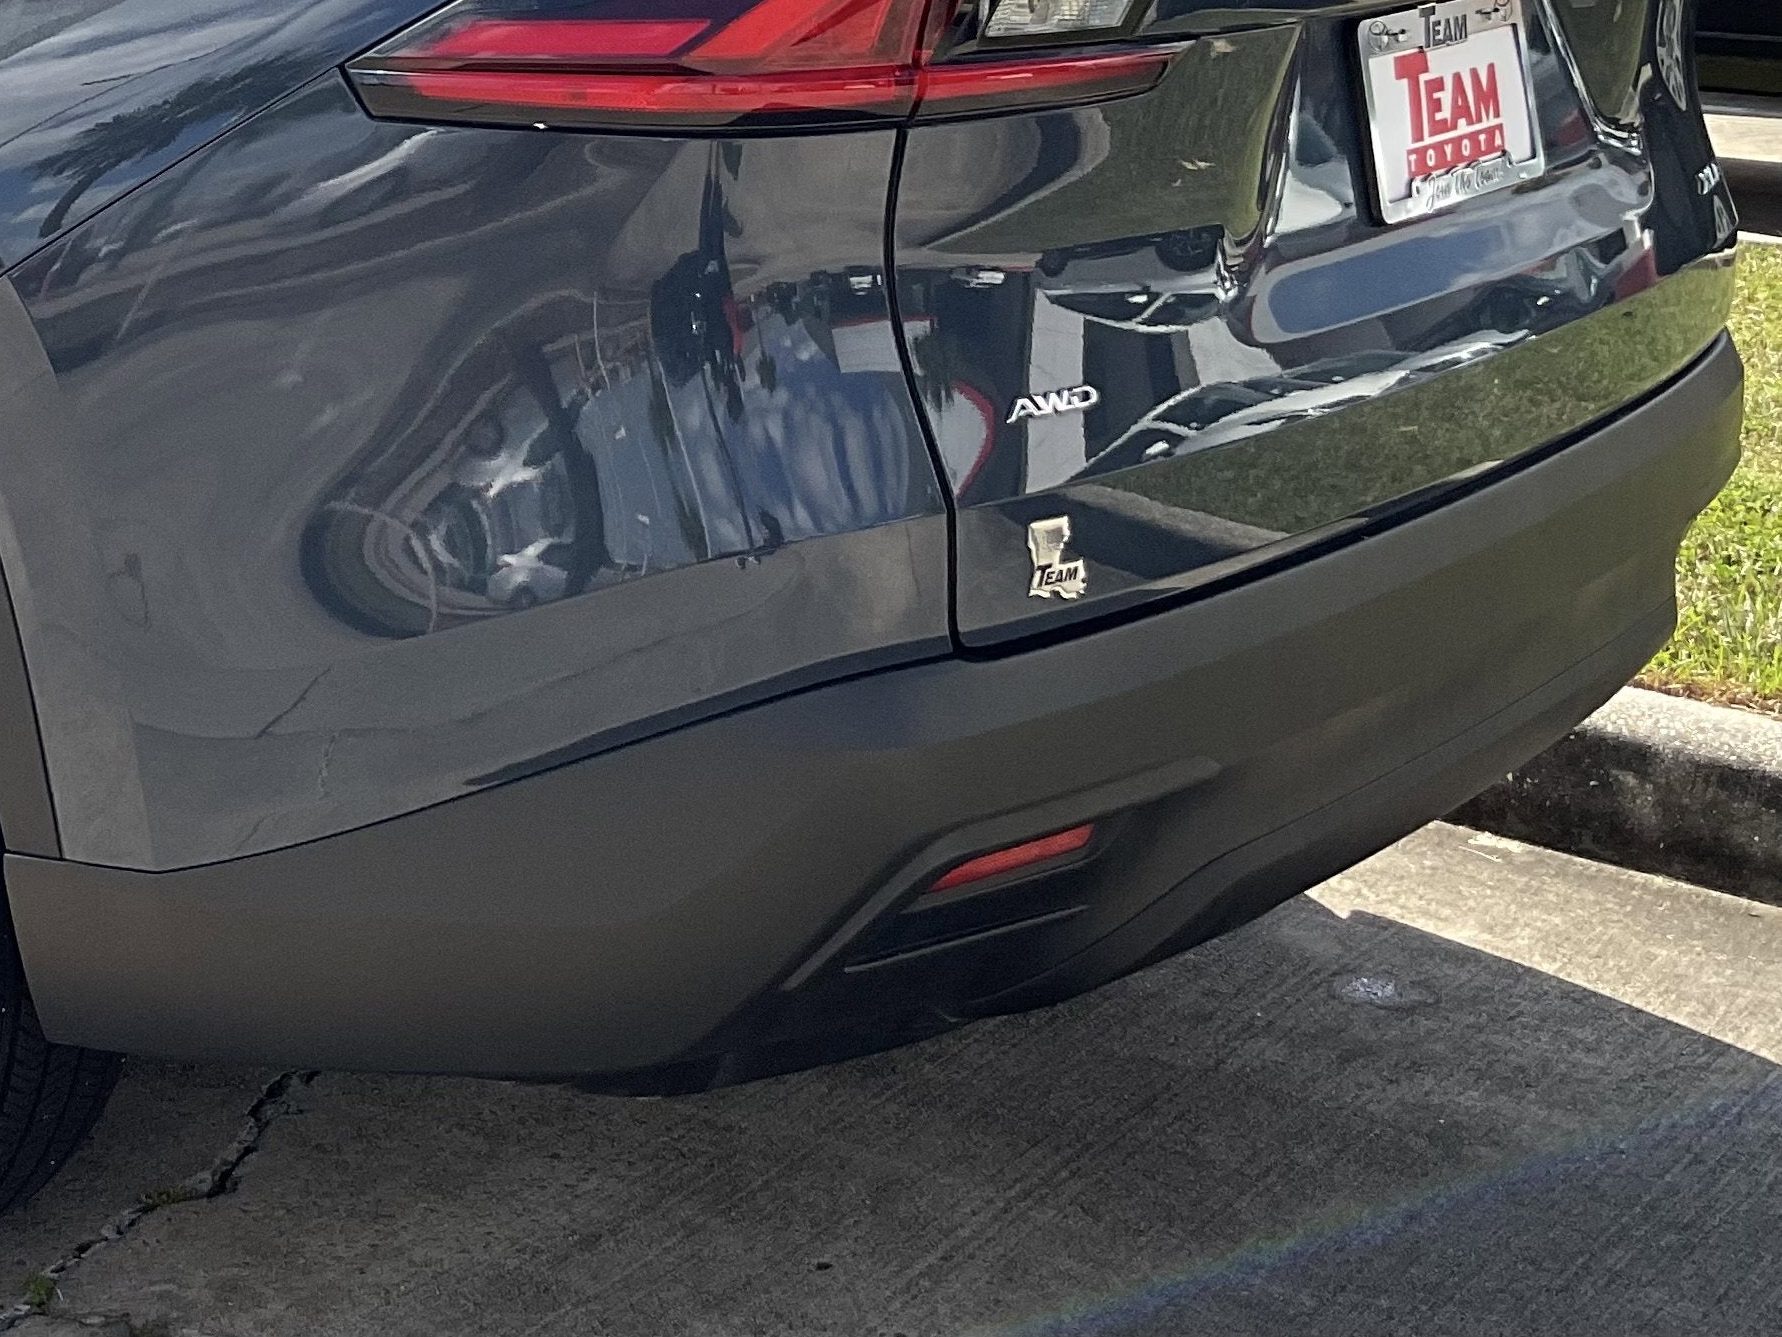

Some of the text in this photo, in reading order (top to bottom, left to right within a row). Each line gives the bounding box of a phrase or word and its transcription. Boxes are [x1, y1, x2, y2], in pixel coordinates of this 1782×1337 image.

[1418, 5, 1468, 49] TEAM
[1393, 49, 1501, 144] TEAM
[1408, 129, 1504, 173] TOYOTA
[1006, 385, 1099, 424] AWD
[1035, 563, 1080, 587] TEAM
